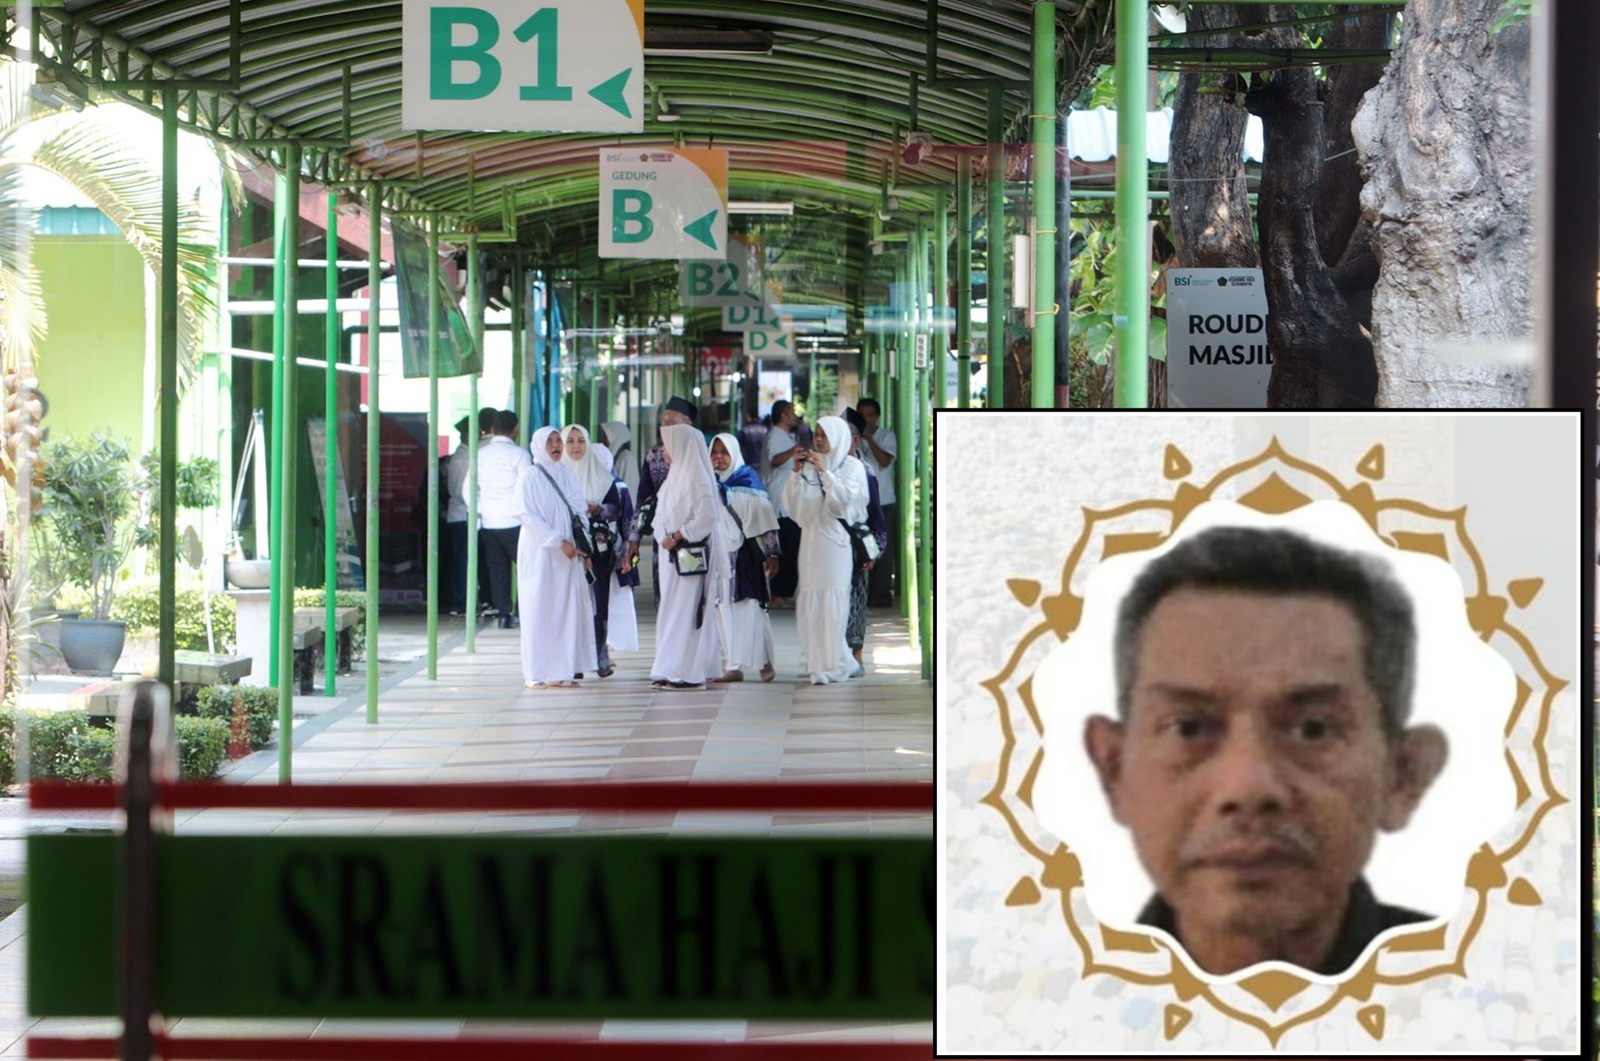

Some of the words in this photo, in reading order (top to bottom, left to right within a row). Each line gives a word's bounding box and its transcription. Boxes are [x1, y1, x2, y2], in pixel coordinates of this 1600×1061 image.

[429, 7, 573, 101] B1
[612, 171, 657, 181] GEDUNG
[612, 189, 654, 243] B
[687, 262, 740, 297] B2
[1174, 276, 1191, 287] BSI
[728, 305, 768, 326] D1
[1189, 314, 1269, 334] ROUD
[749, 331, 768, 350] D
[276, 849, 628, 1002] SRAMA
[656, 853, 877, 1001] HAJI
